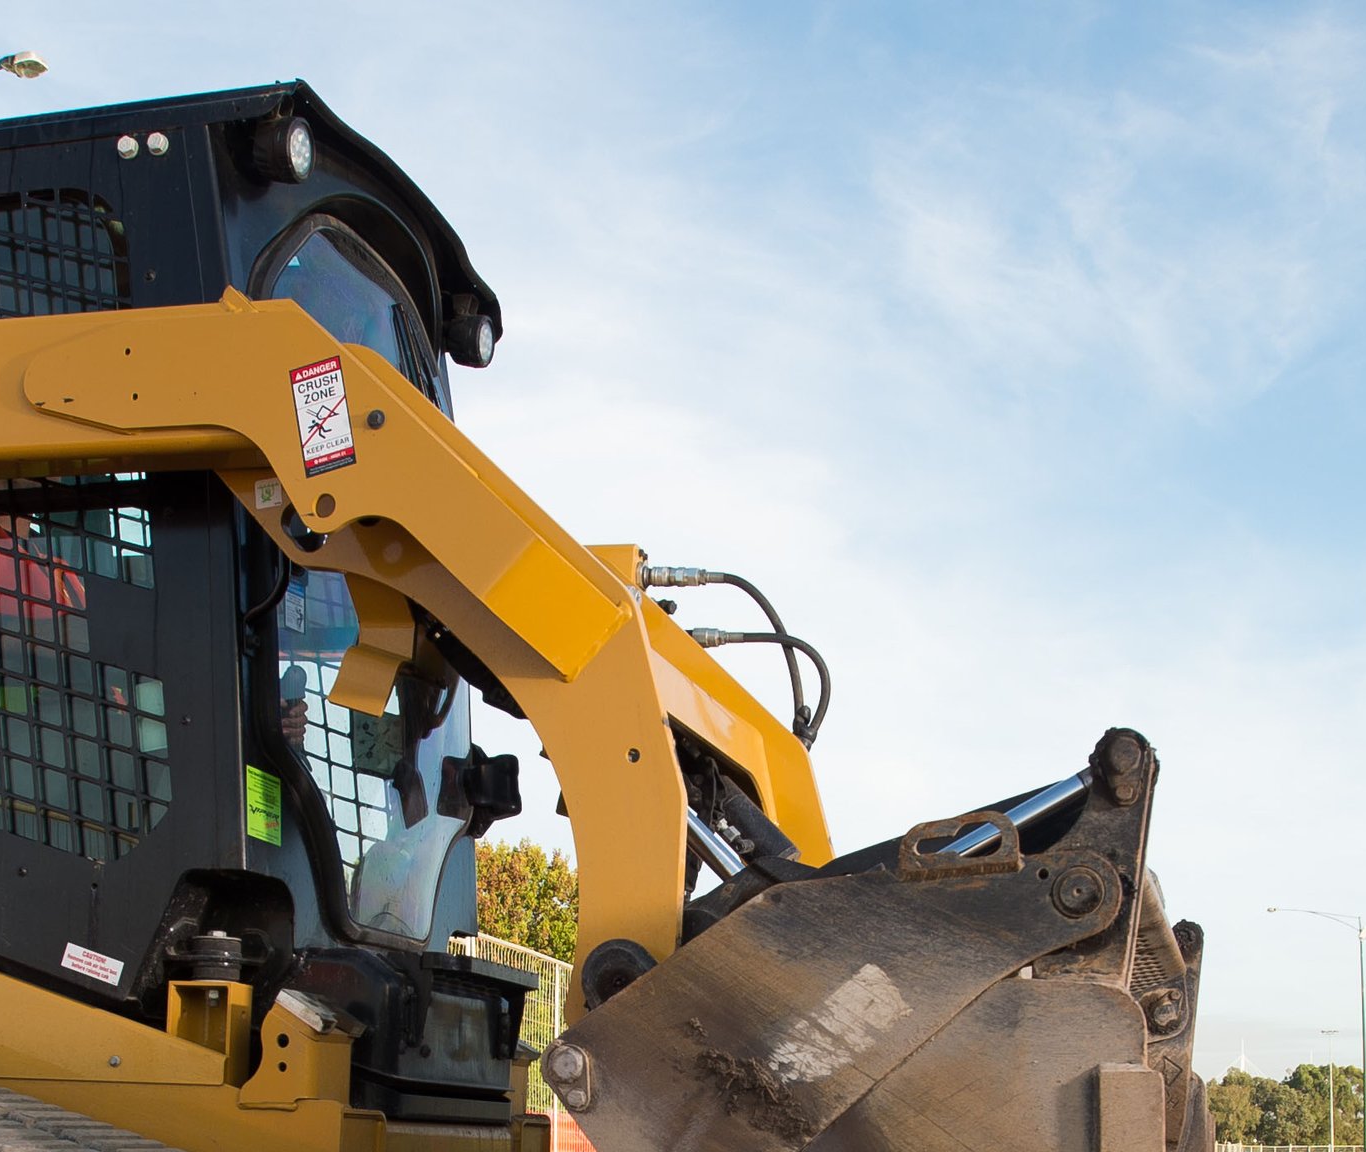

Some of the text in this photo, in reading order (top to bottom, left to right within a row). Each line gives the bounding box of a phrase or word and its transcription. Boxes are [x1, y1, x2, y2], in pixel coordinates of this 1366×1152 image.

[302, 360, 337, 378] DANGER
[297, 373, 339, 394] CRUSH
[303, 386, 336, 405] ZONE
[306, 436, 350, 456] KEEP CLEAR
